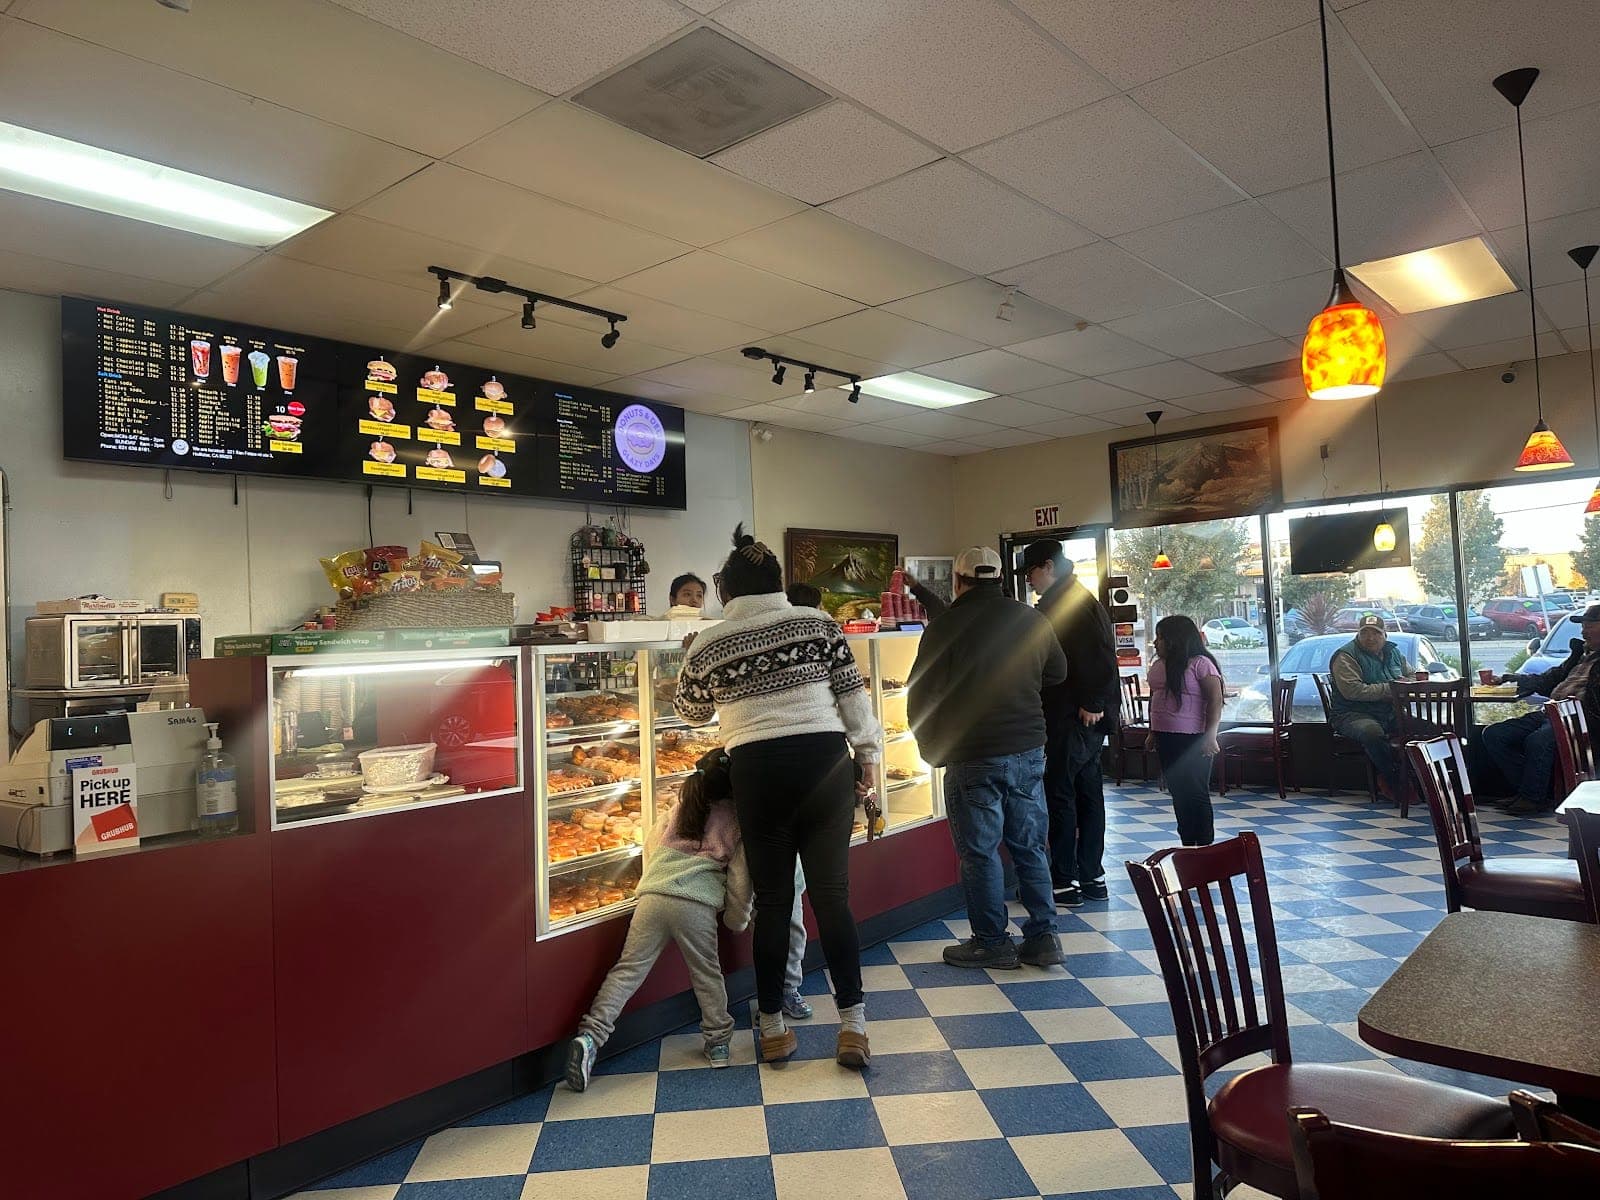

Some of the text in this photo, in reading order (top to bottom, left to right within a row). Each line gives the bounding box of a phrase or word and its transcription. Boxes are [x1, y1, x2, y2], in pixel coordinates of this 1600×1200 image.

[275, 405, 286, 413] 10
[618, 408, 645, 432] DONUTS
[622, 449, 662, 468] GLAZY DAYS
[1034, 506, 1059, 527] EXIT
[295, 639, 319, 647] Yellow
[319, 637, 351, 646] Sandwich
[351, 637, 370, 646] Wrap
[1118, 636, 1134, 644] VISA
[91, 767, 119, 776] GRUBHUB
[80, 778, 131, 791] Pick up
[80, 789, 131, 809] HERE
[100, 822, 134, 841] GRUBHUB
